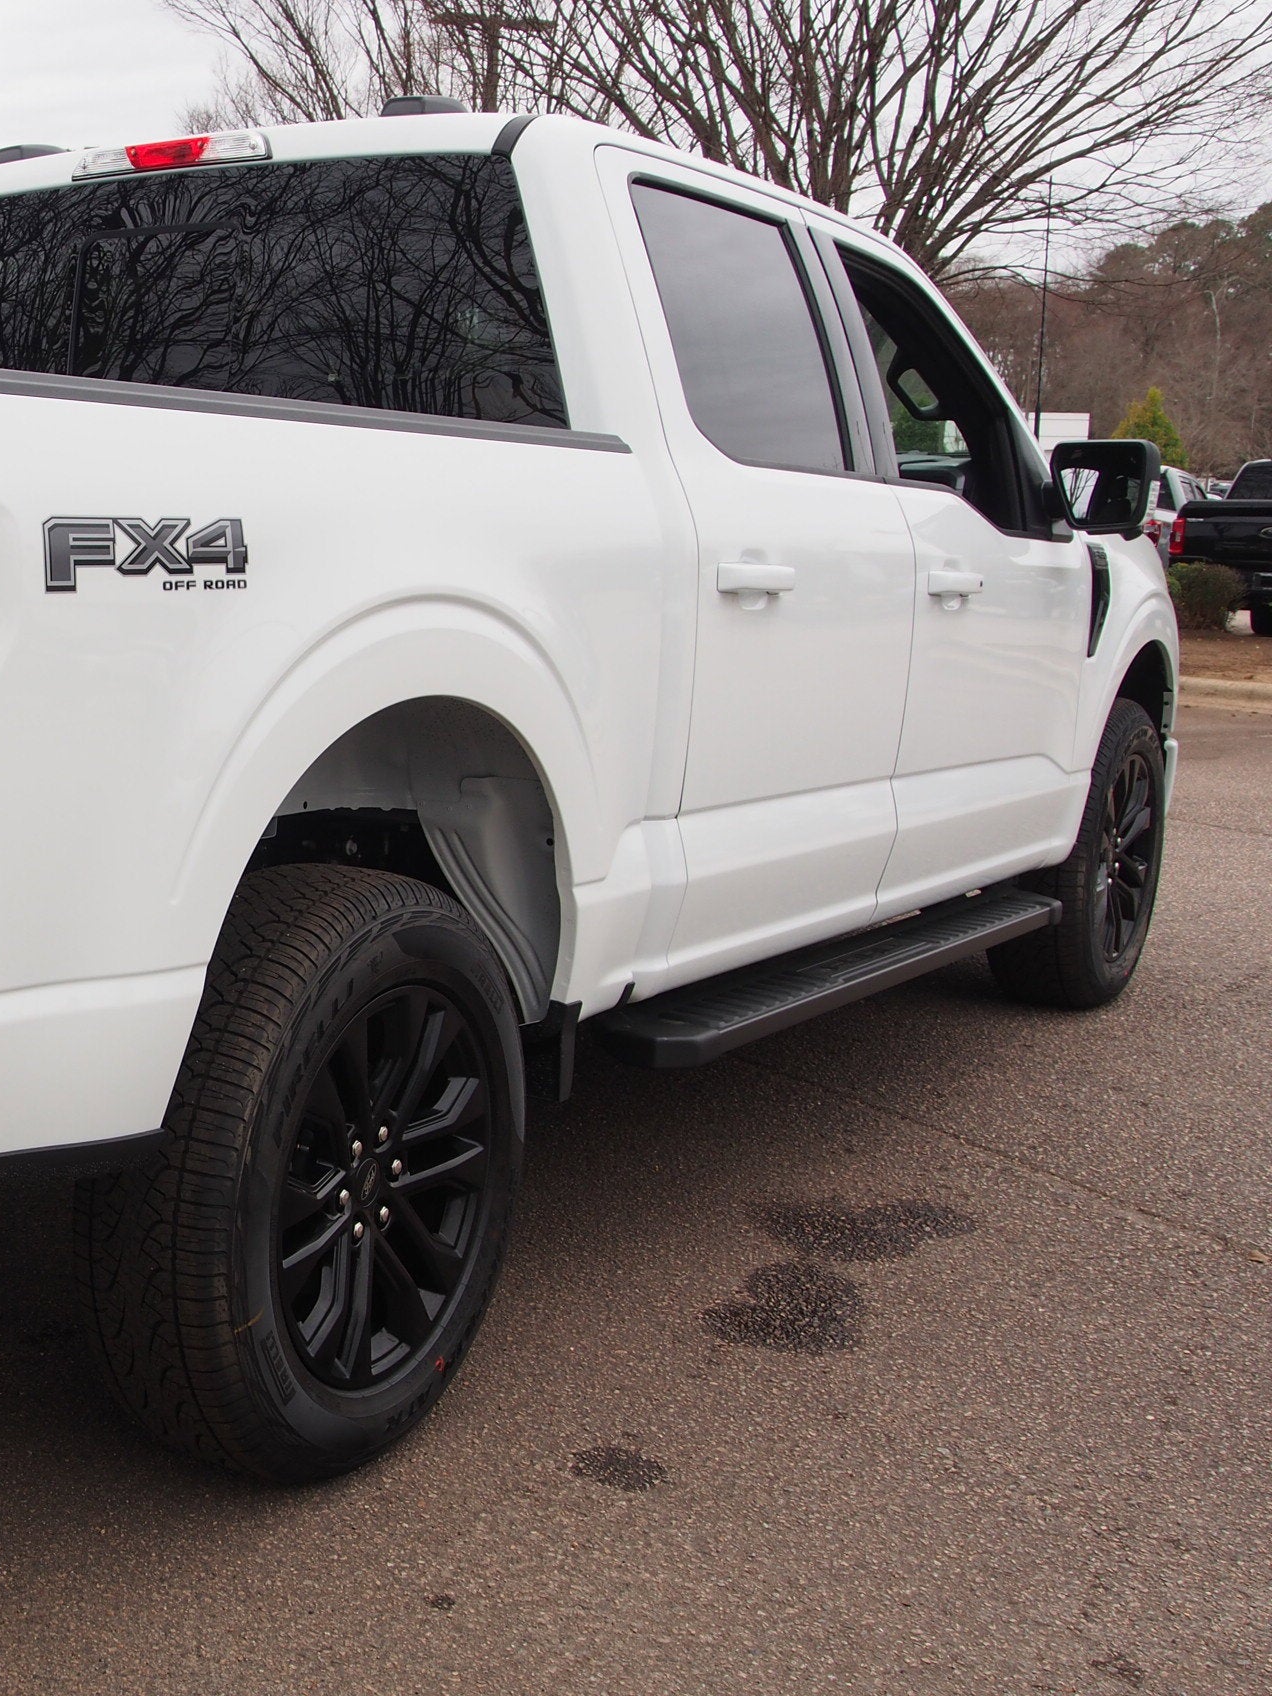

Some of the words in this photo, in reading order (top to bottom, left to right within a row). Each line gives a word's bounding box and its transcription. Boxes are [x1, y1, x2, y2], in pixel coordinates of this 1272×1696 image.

[42, 516, 248, 593] FX4
[162, 580, 197, 591] OFF
[203, 579, 247, 590] ROAD
